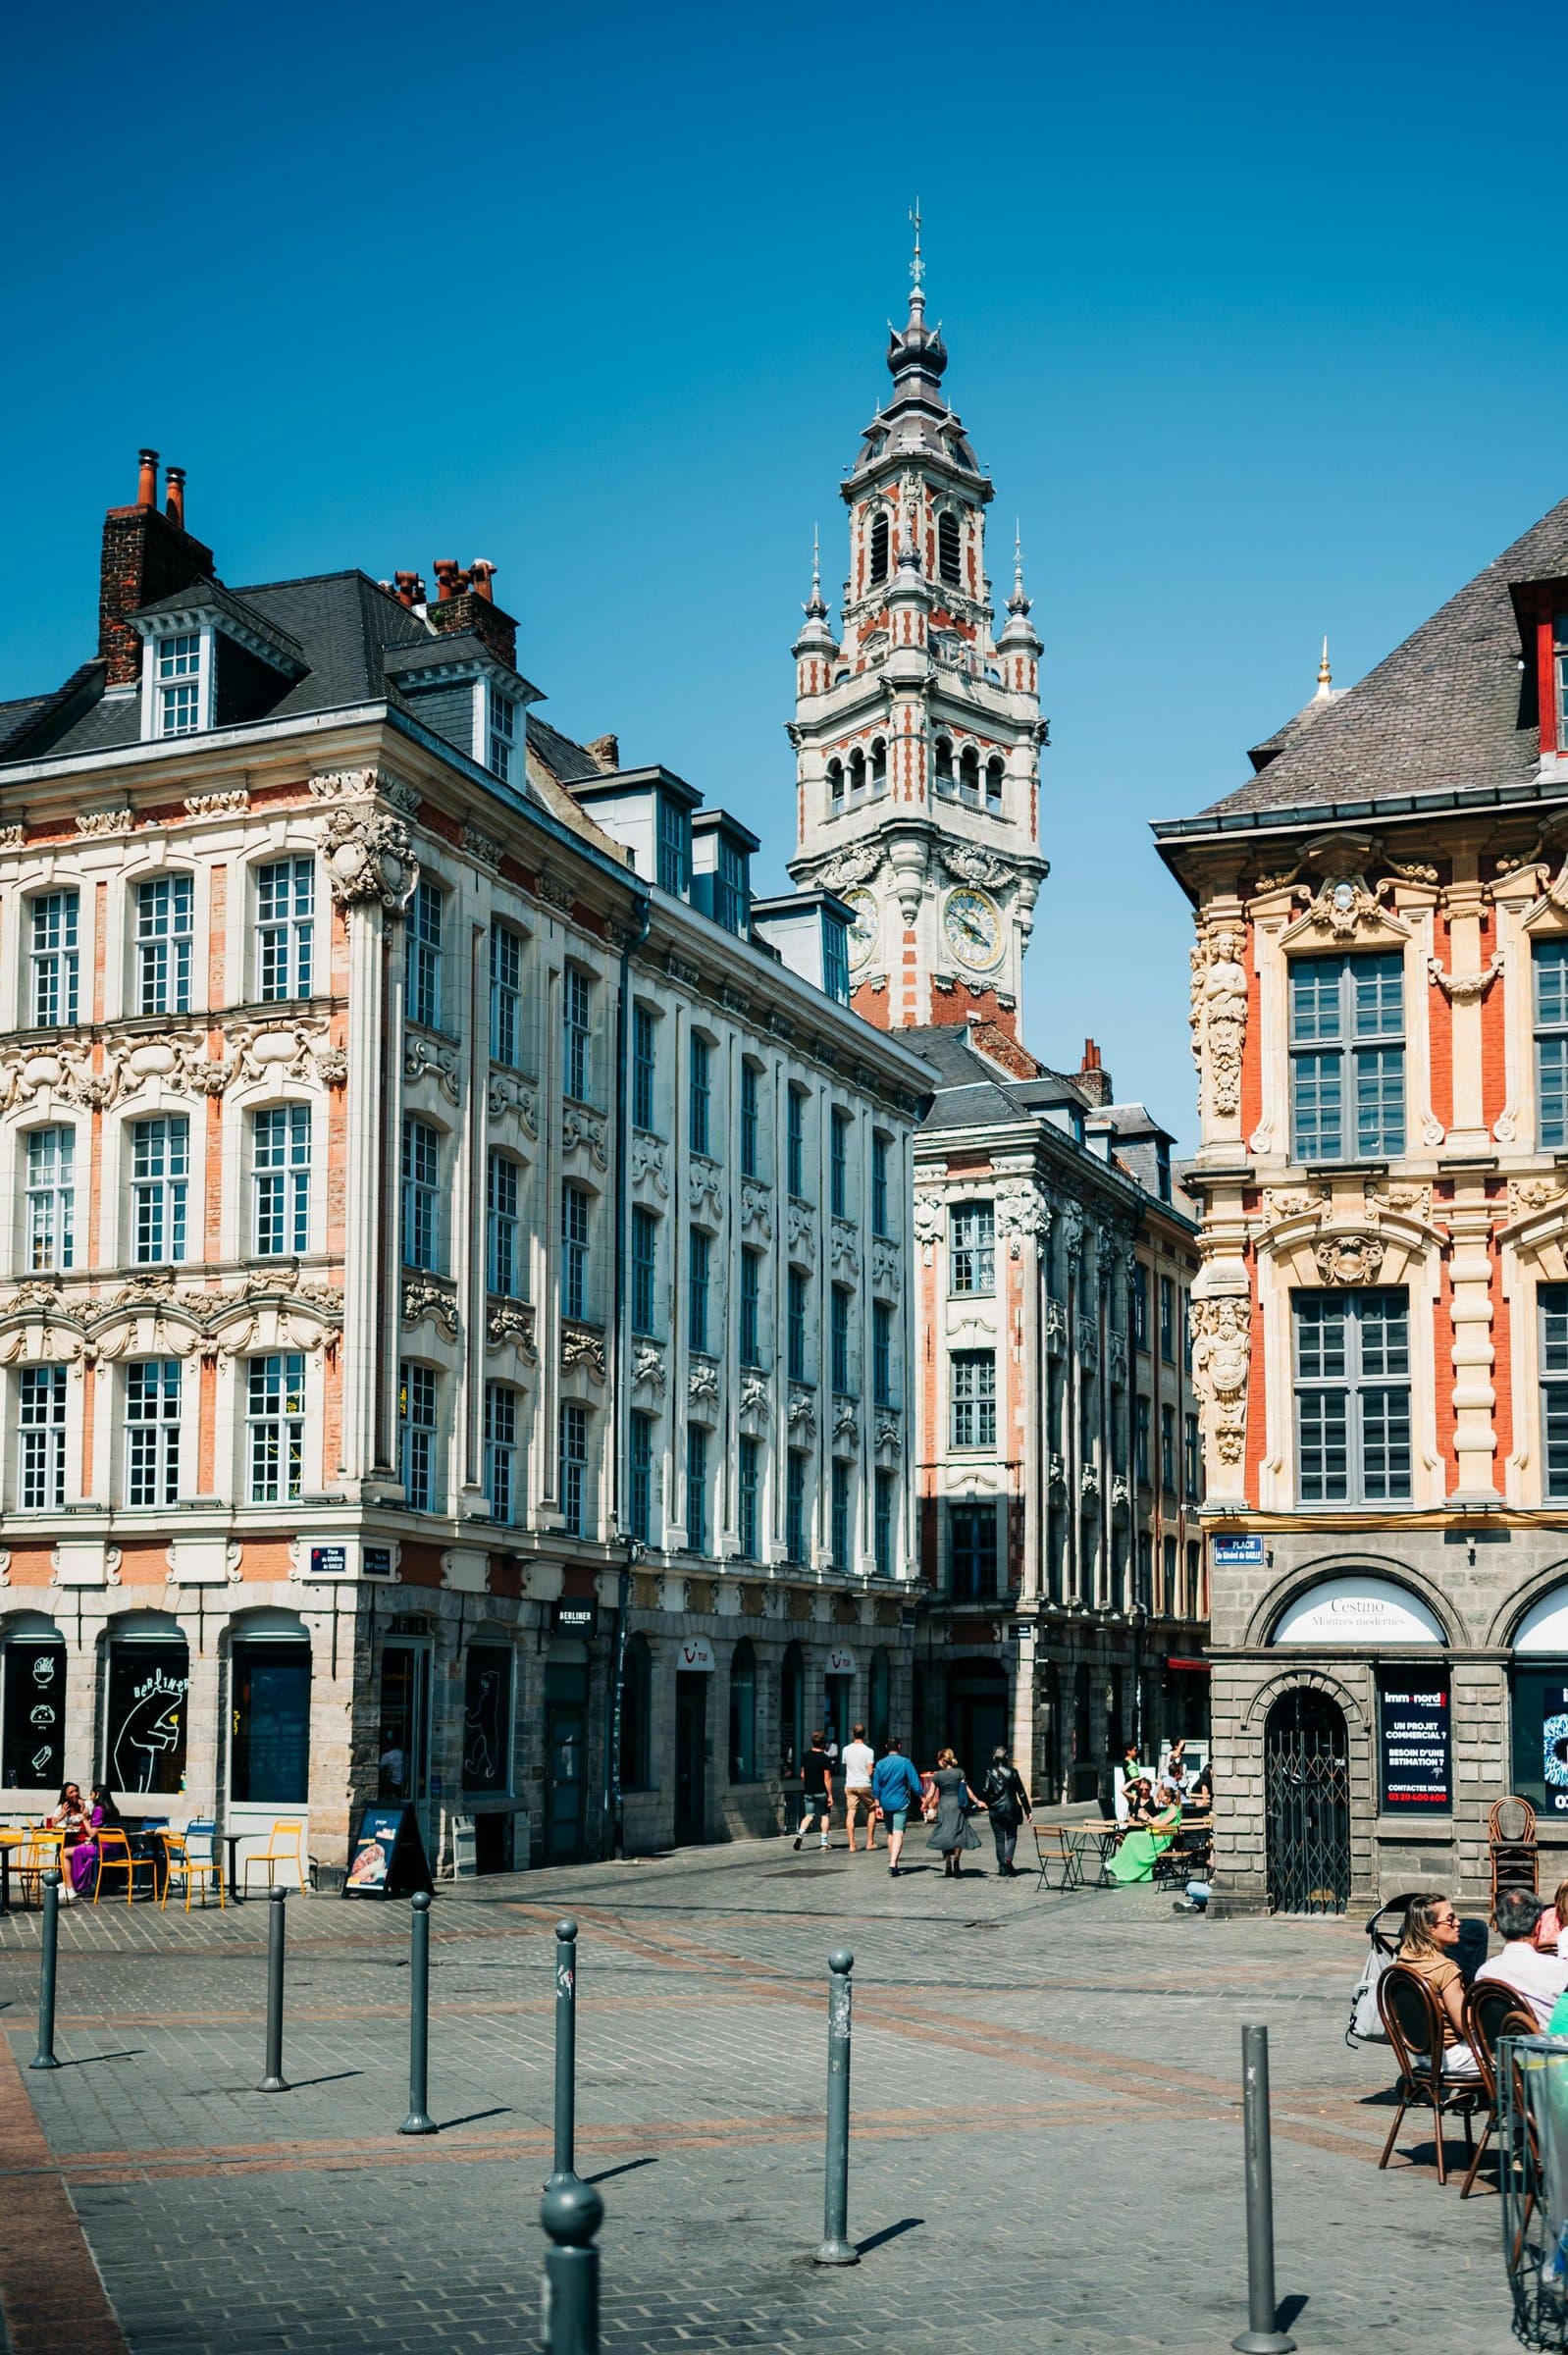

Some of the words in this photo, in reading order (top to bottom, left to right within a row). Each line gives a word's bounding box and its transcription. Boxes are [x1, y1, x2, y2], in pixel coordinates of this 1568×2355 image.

[1232, 1541, 1255, 1549] PLACE
[1331, 1597, 1385, 1613] Cestino
[559, 1611, 592, 1620] BERLINER
[1312, 1616, 1353, 1626] Montres
[1356, 1616, 1405, 1626] modernes
[1385, 1731, 1440, 1740] COMMERCIAL
[1441, 1731, 1447, 1740] ?
[1419, 1749, 1444, 1757] D'UNE
[1388, 1757, 1438, 1766] ESTIMATION
[1438, 1757, 1444, 1766] ?
